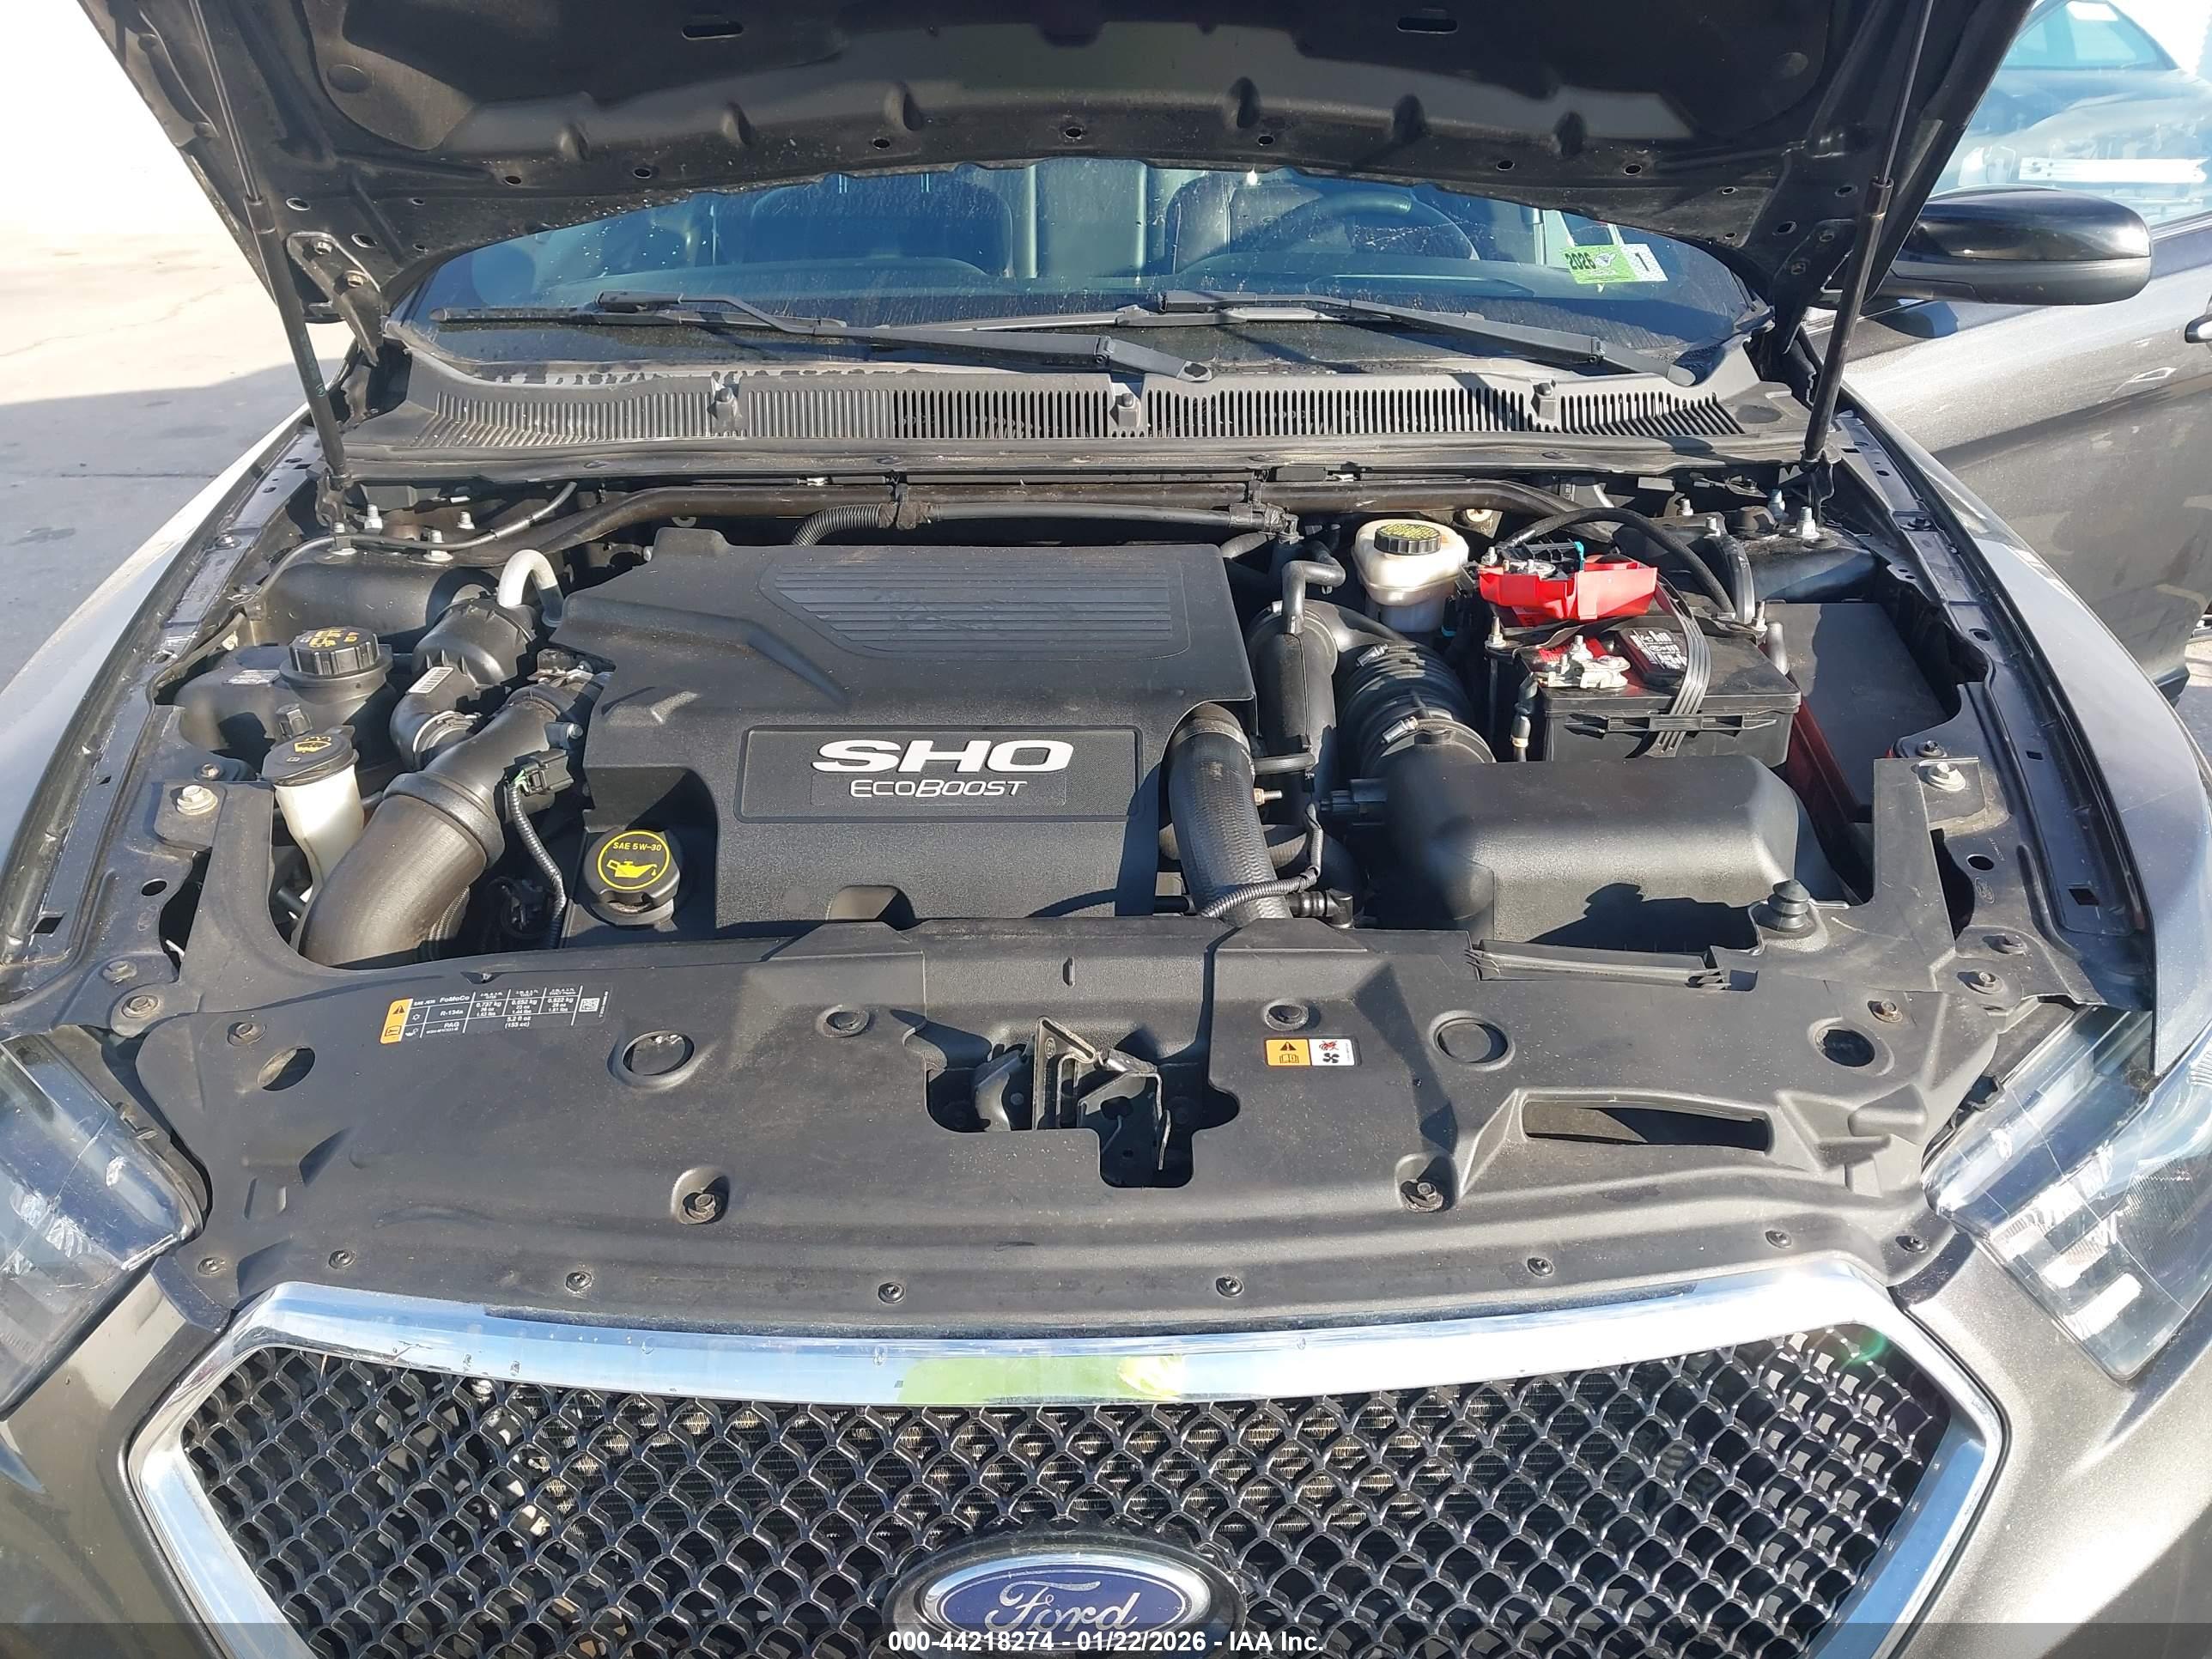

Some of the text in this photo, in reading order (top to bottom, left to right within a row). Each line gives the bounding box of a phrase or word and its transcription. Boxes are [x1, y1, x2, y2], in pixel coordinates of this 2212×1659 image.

[1565, 252, 1596, 270] 2026
[811, 739, 1073, 773] SHO
[612, 842, 662, 852] SAE 5W-30
[984, 1580, 1141, 1633] Ford
